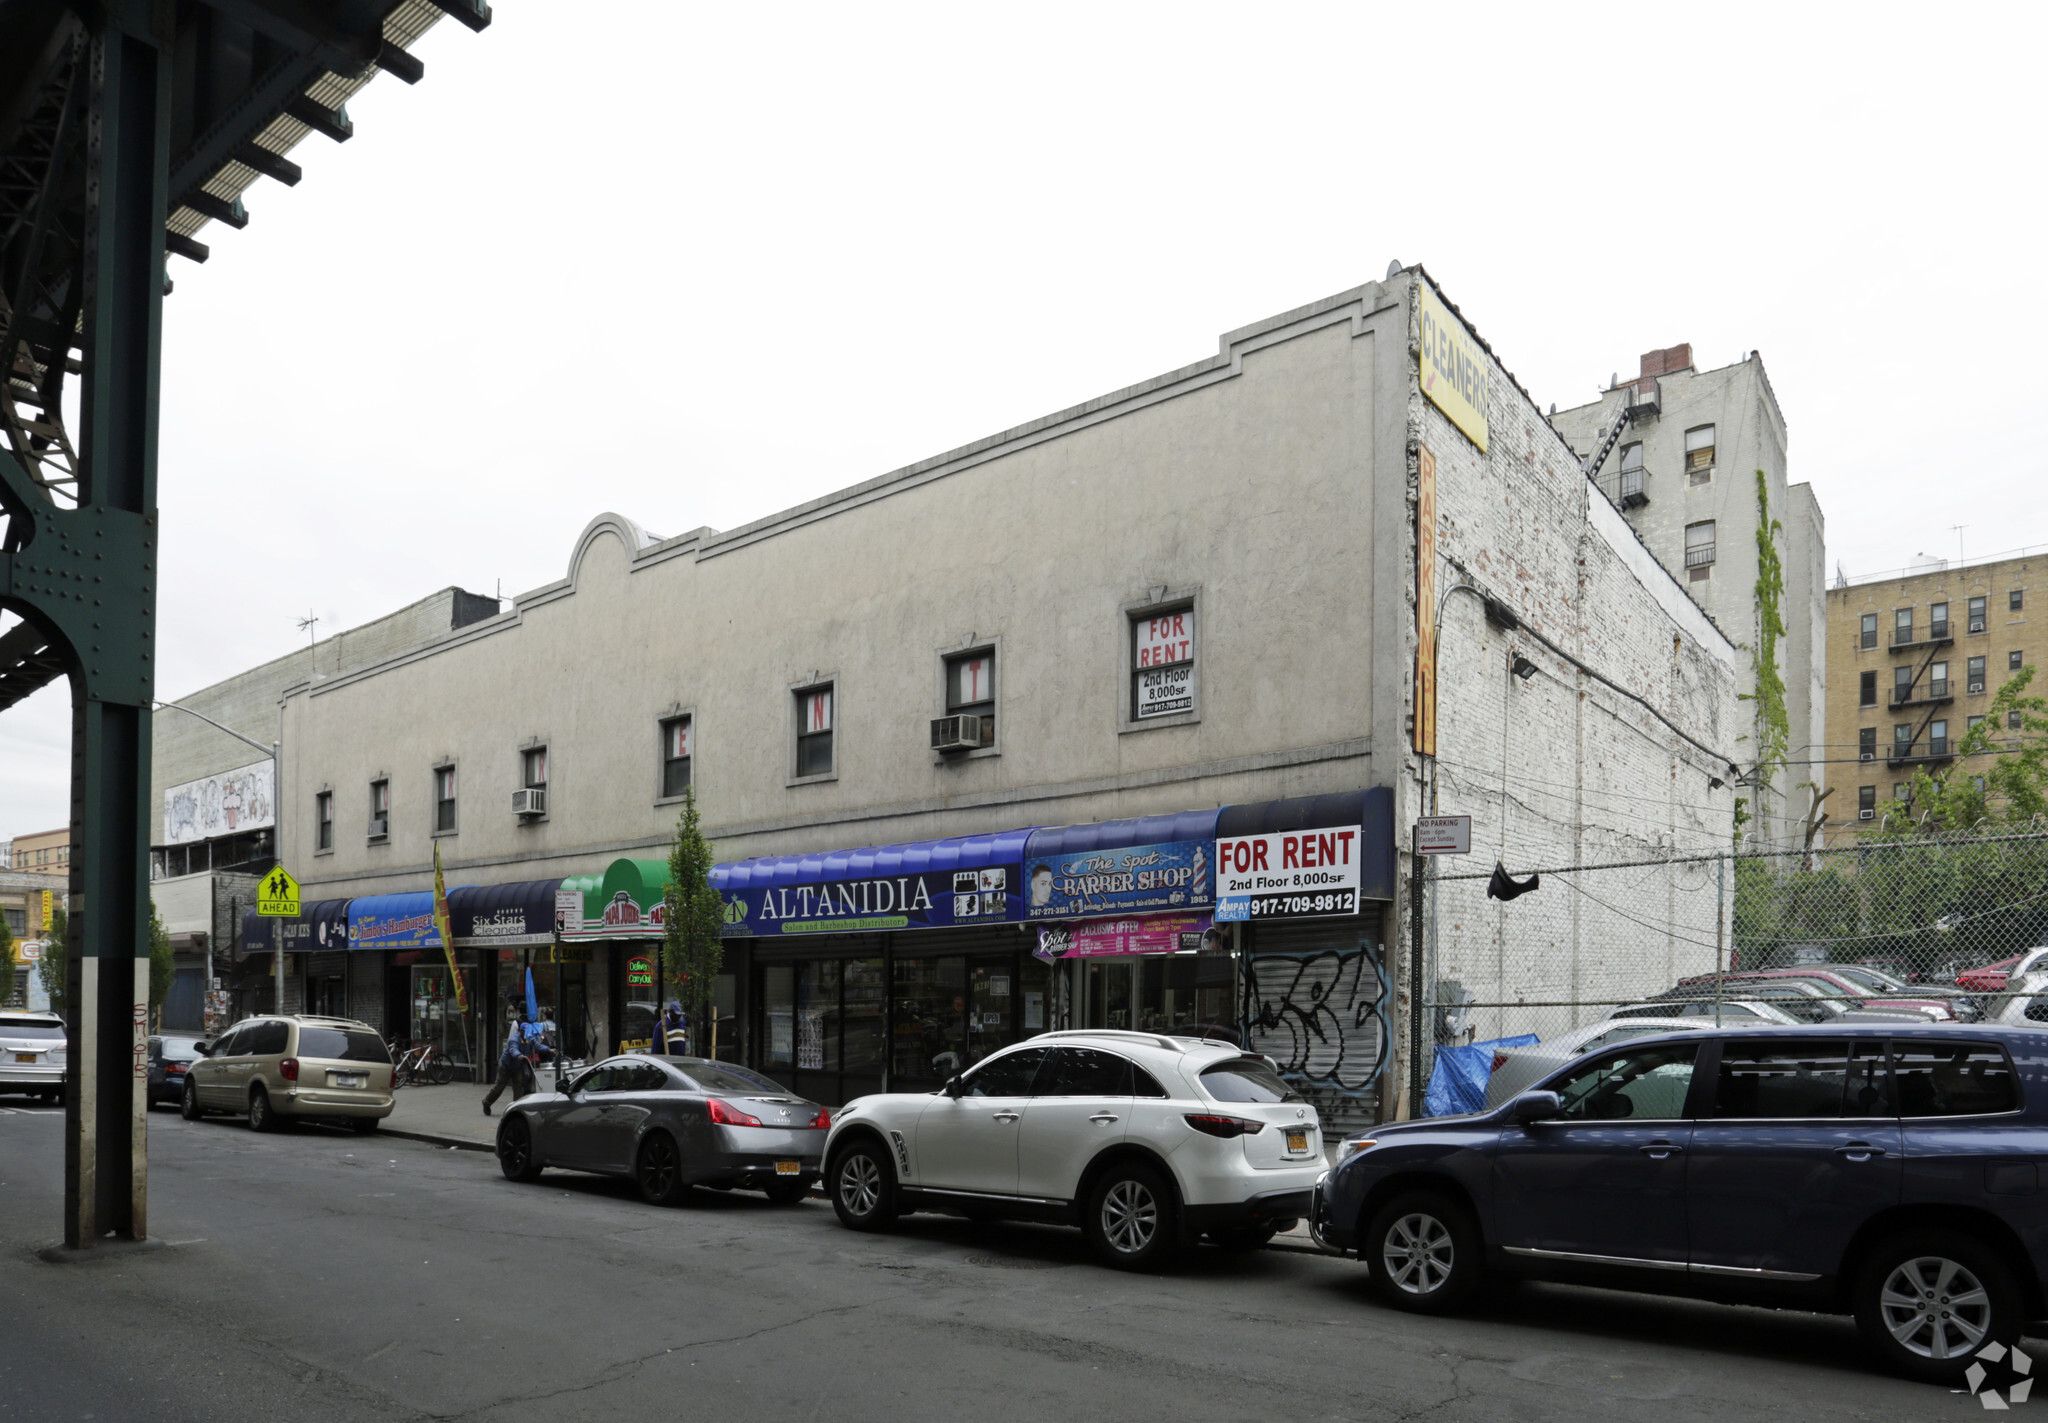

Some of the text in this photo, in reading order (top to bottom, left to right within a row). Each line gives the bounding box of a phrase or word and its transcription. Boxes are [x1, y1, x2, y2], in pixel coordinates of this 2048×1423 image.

[1423, 310, 1486, 420] CLEANERS
[1421, 454, 1432, 696] PARKING
[1150, 614, 1185, 641] FOR
[1141, 640, 1190, 667] RENT
[1144, 668, 1190, 688] 2nd Floor
[1431, 819, 1459, 827] PARKING
[1220, 830, 1355, 874] FOR RENT
[1085, 856, 1115, 871] The
[1062, 867, 1193, 897] BARBER SHOP
[1229, 878, 1252, 891] 2nd
[1257, 876, 1289, 889] Floor
[262, 903, 296, 913] AHEAD
[759, 876, 933, 920] ALTANIDIA
[1217, 893, 1354, 915] AMPAY 917-709-9812
[472, 914, 526, 926] Six Stars
[606, 904, 620, 925] PAPA
[784, 918, 905, 932] Salon and Barbeshop Distributors
[1218, 911, 1248, 920] REALTY
[359, 920, 387, 940] Jimbo's
[388, 914, 432, 935] Hamburger
[472, 924, 526, 936] Cleaners
[1080, 920, 1139, 937] EXCLUSIVE OFFER
[1040, 931, 1067, 953] Spot
